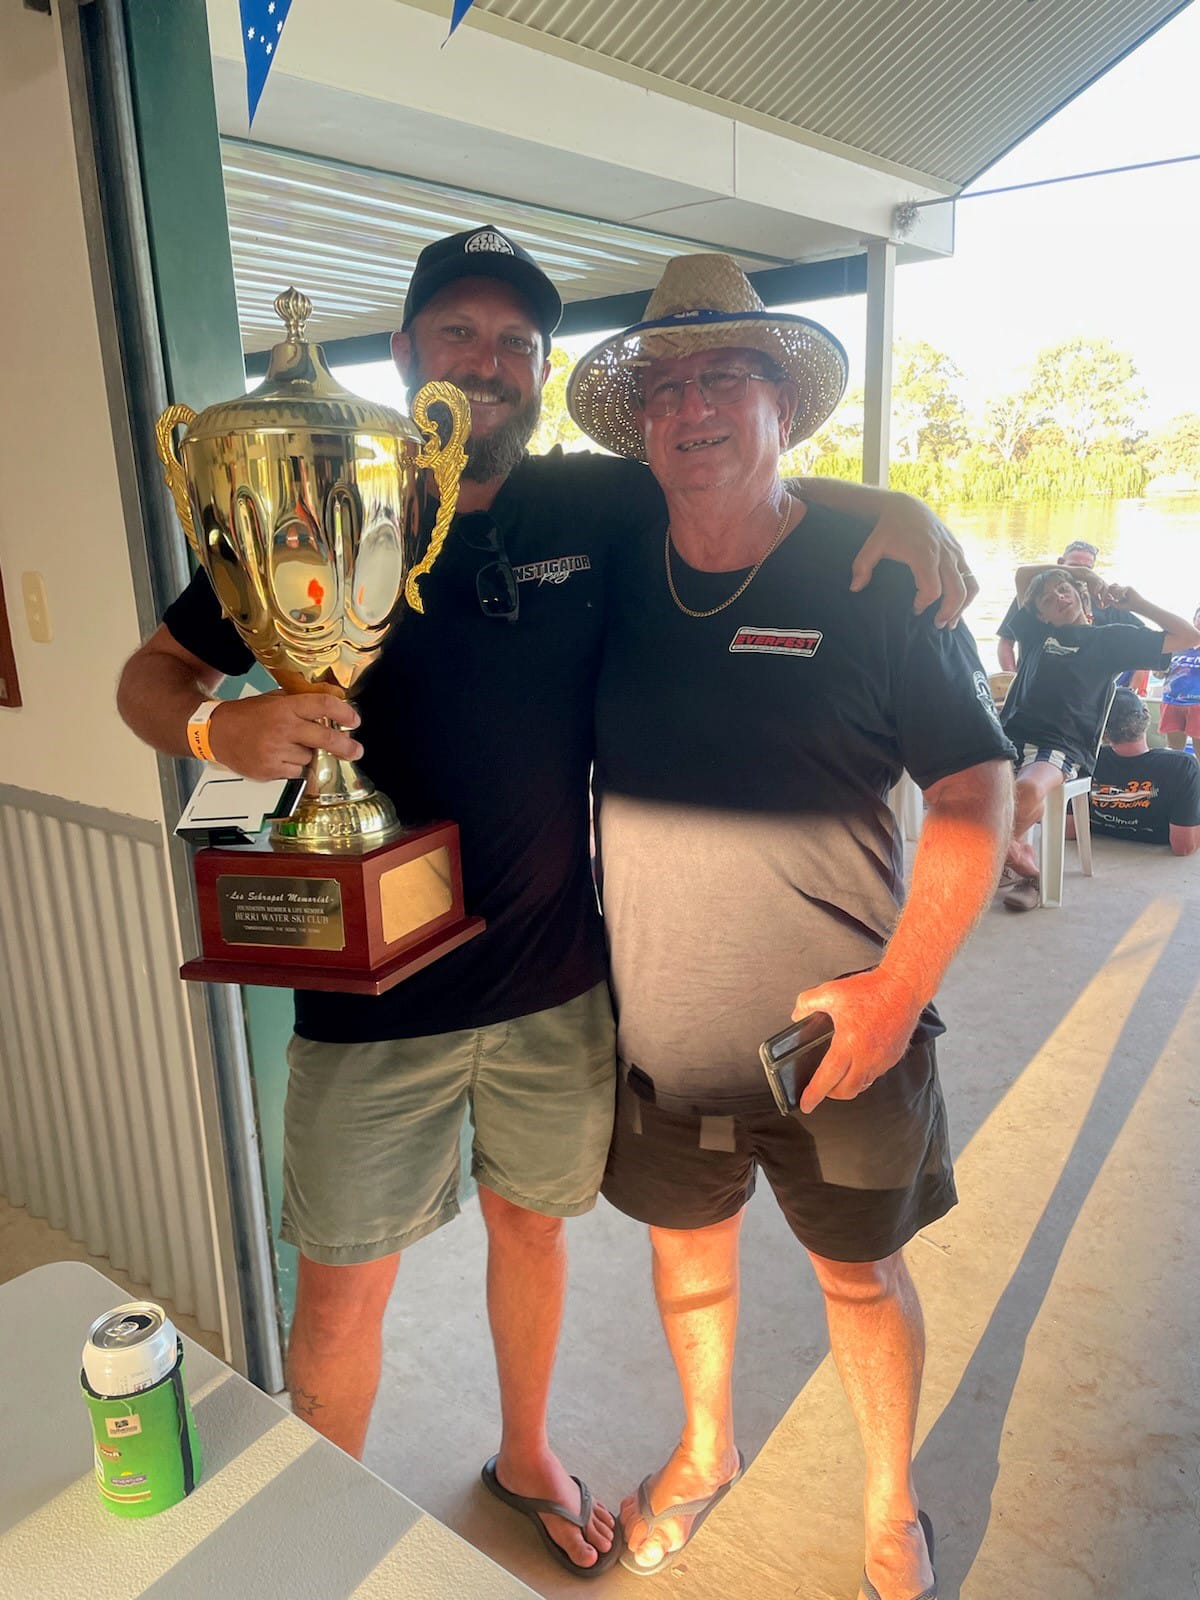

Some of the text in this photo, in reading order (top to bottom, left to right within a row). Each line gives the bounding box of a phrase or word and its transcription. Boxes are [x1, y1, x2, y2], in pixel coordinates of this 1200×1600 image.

[513, 556, 590, 581] NSTIGATOR
[287, 893, 329, 904] Memorial
[235, 911, 329, 924] BERRI WATER SKI CLUB
